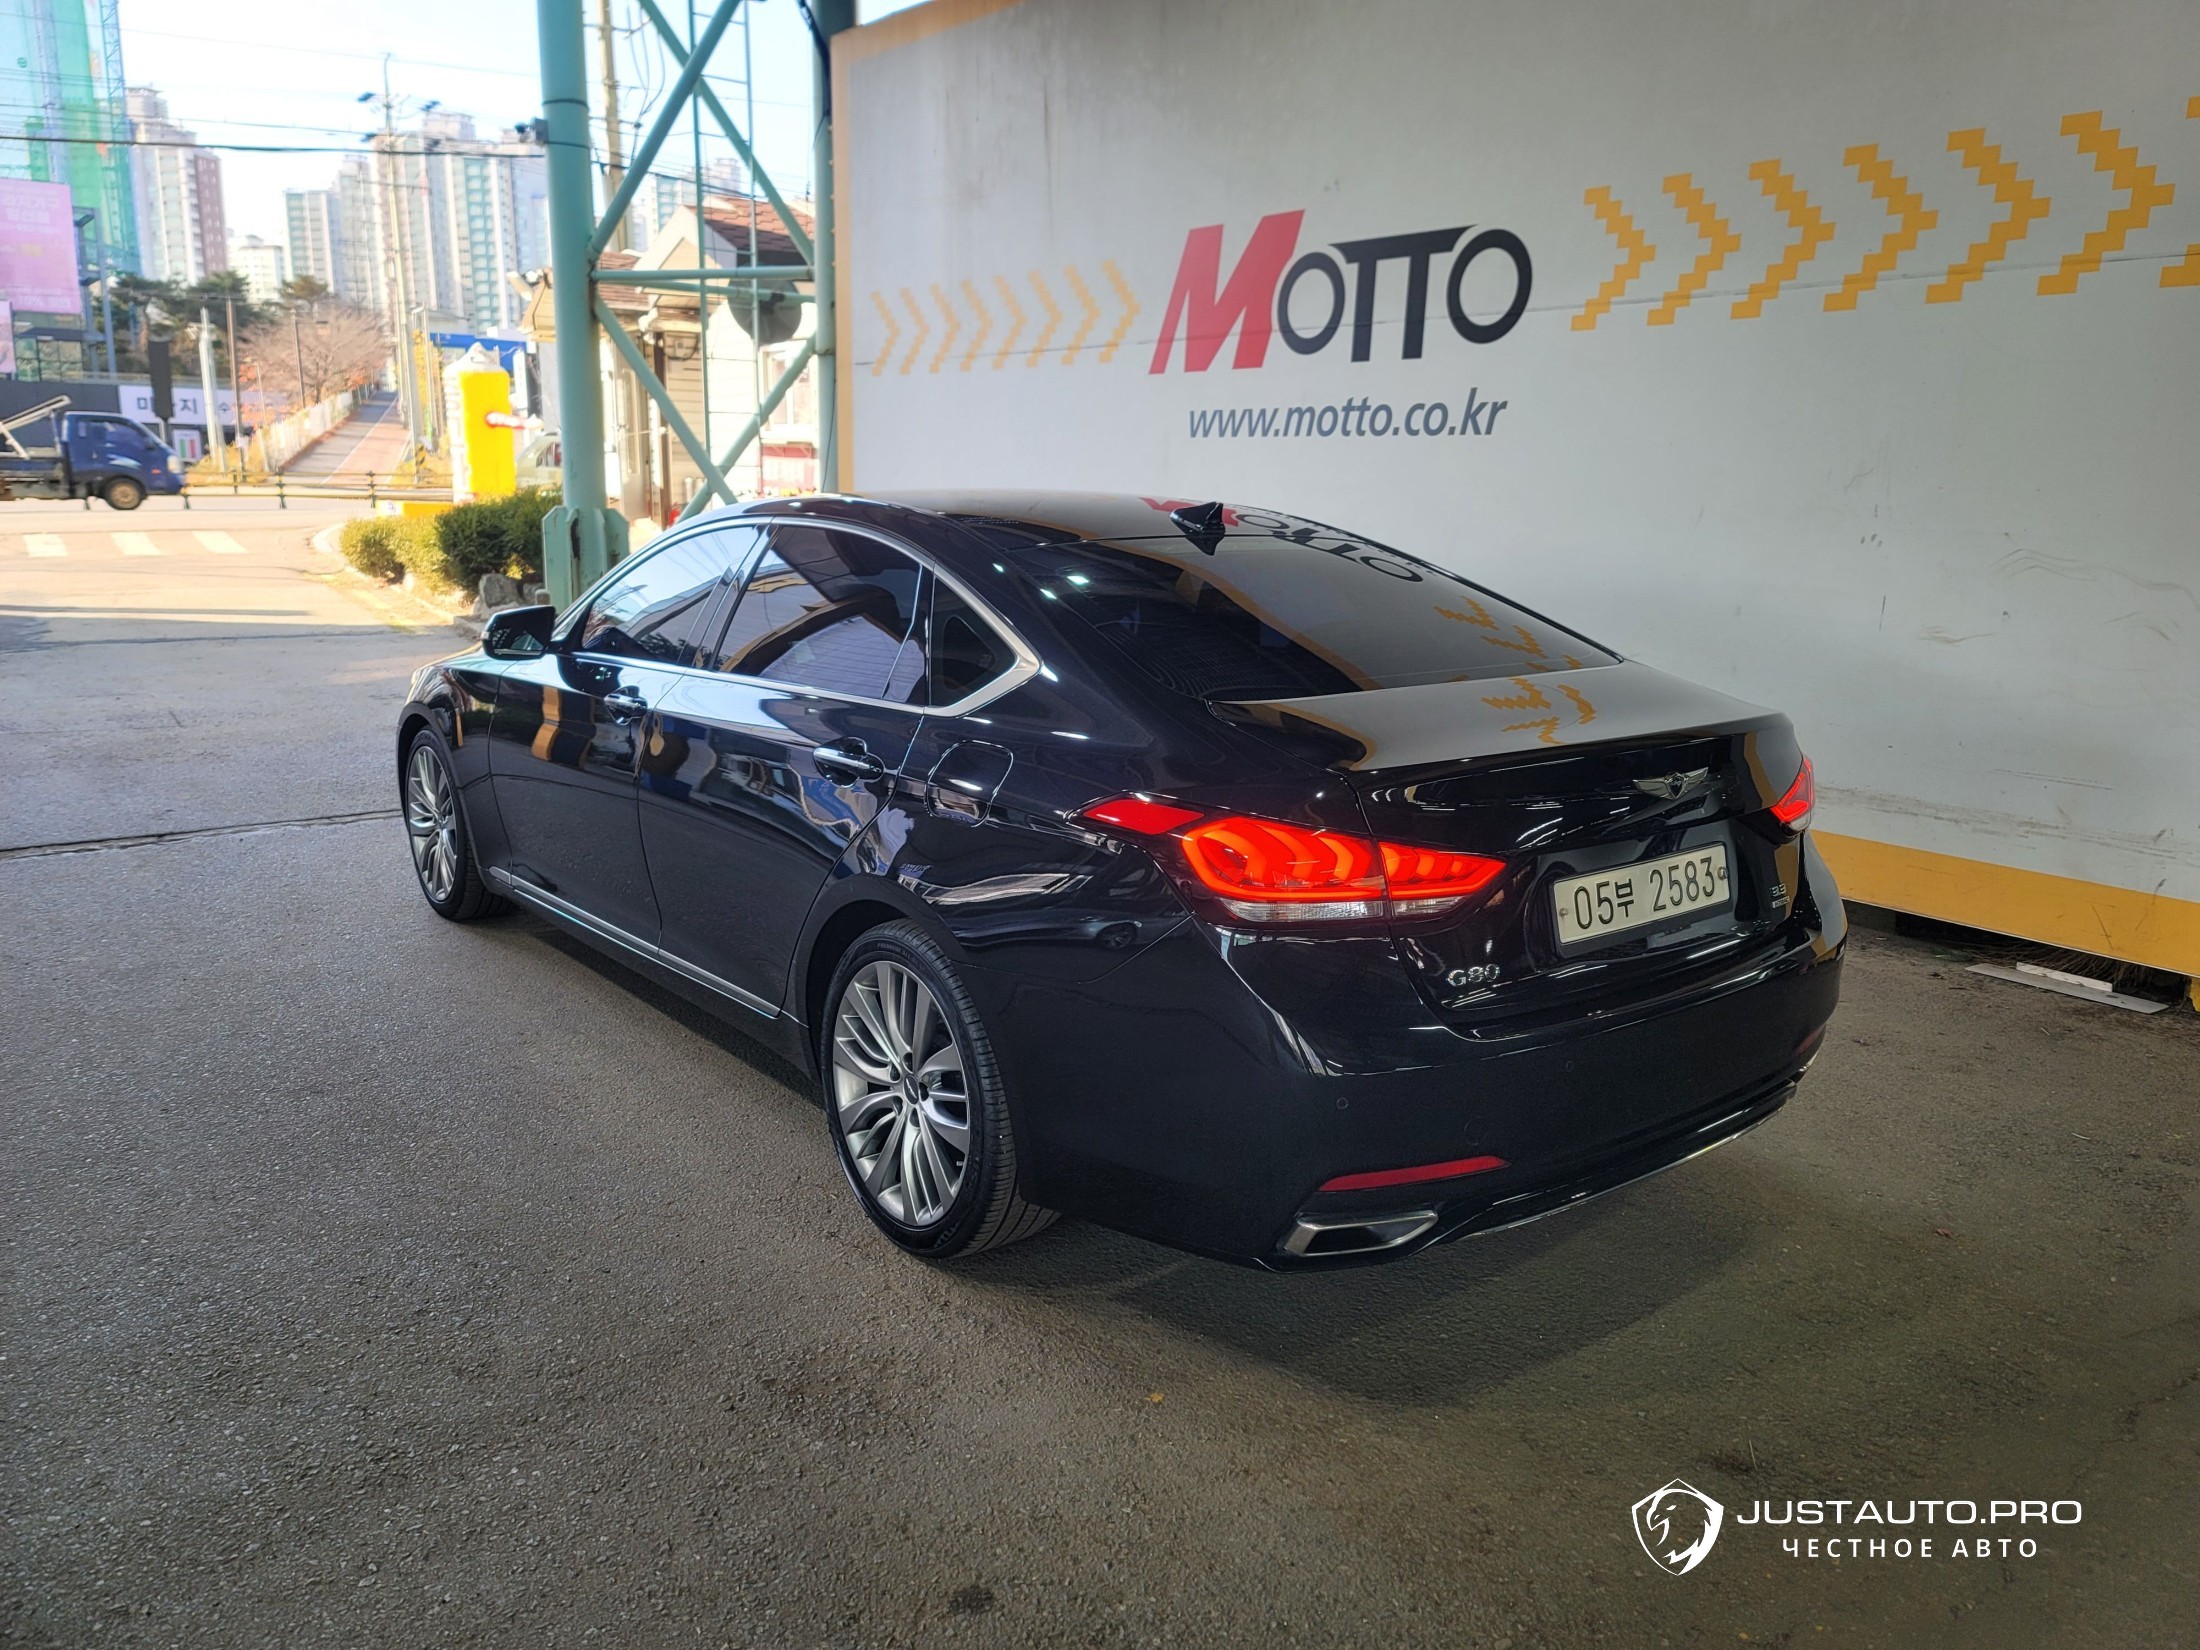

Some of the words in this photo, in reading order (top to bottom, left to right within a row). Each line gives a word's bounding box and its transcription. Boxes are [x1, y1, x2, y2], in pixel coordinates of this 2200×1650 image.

[1148, 209, 1533, 375] MOTTO
[1188, 387, 1508, 439] www.motto.co.kr
[1574, 878, 1634, 929] 05부
[1650, 856, 1715, 912] 2583
[1446, 963, 1500, 987] G80
